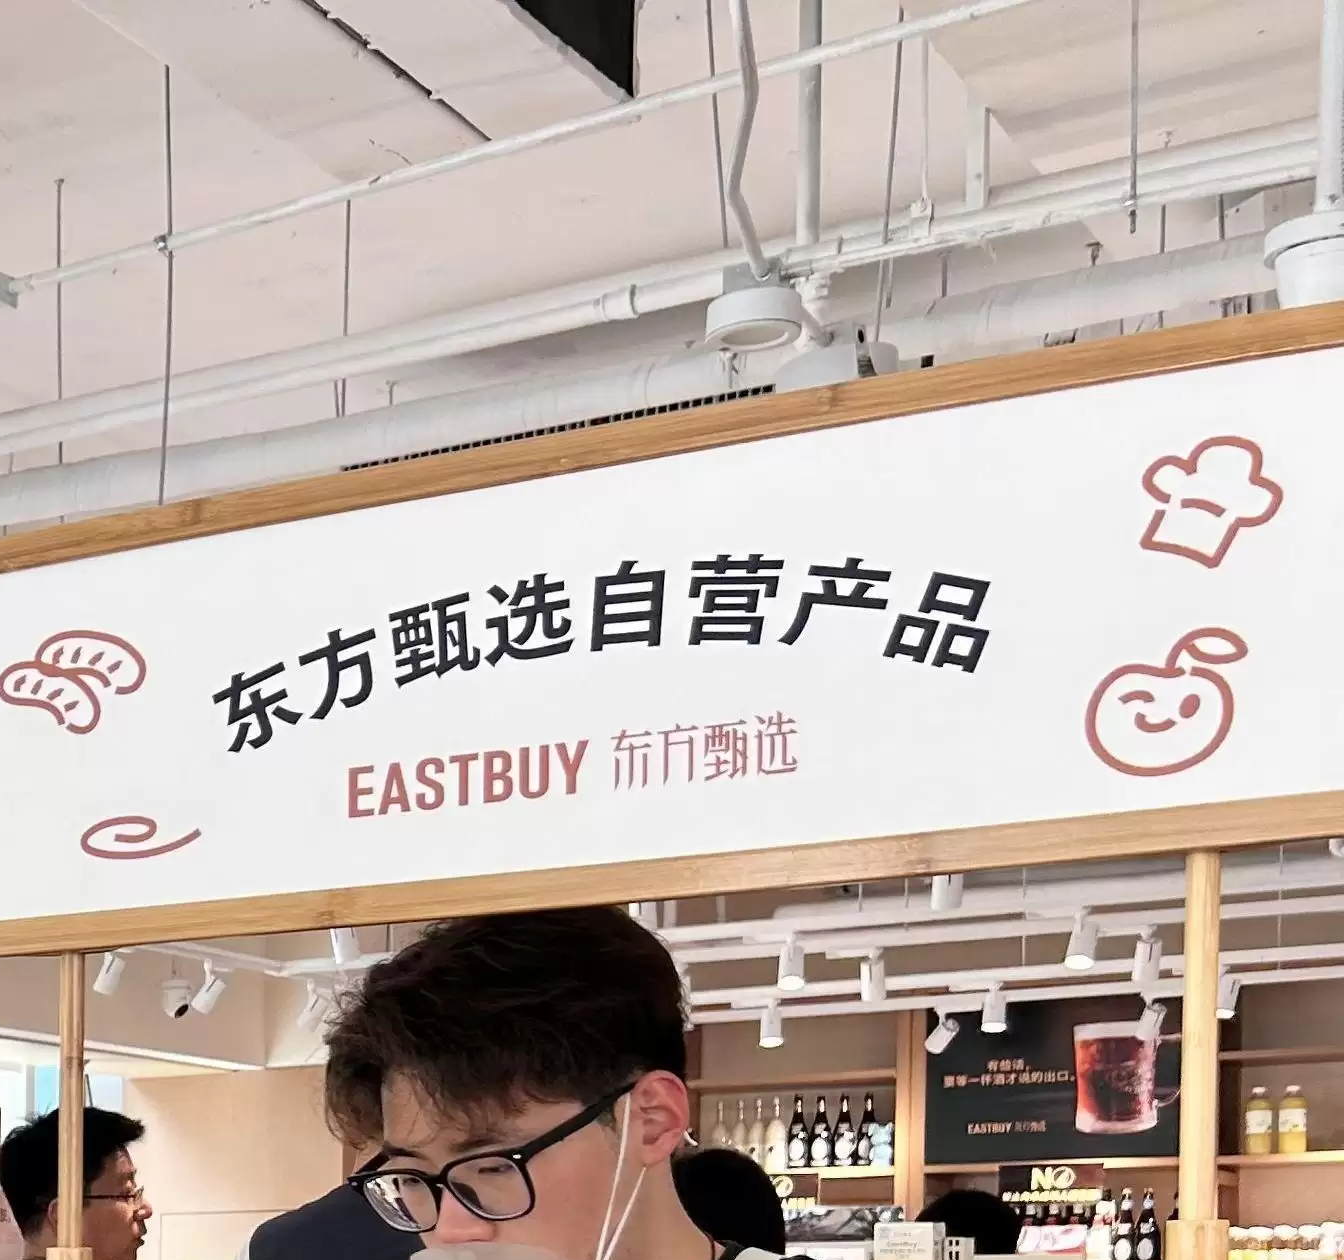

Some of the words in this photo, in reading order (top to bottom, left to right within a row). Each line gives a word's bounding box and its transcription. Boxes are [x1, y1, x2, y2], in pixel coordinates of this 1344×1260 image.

[211, 553, 994, 755] 东方甄选自营产品
[347, 738, 589, 818] EASTBUY
[610, 710, 799, 794] 东方甄选
